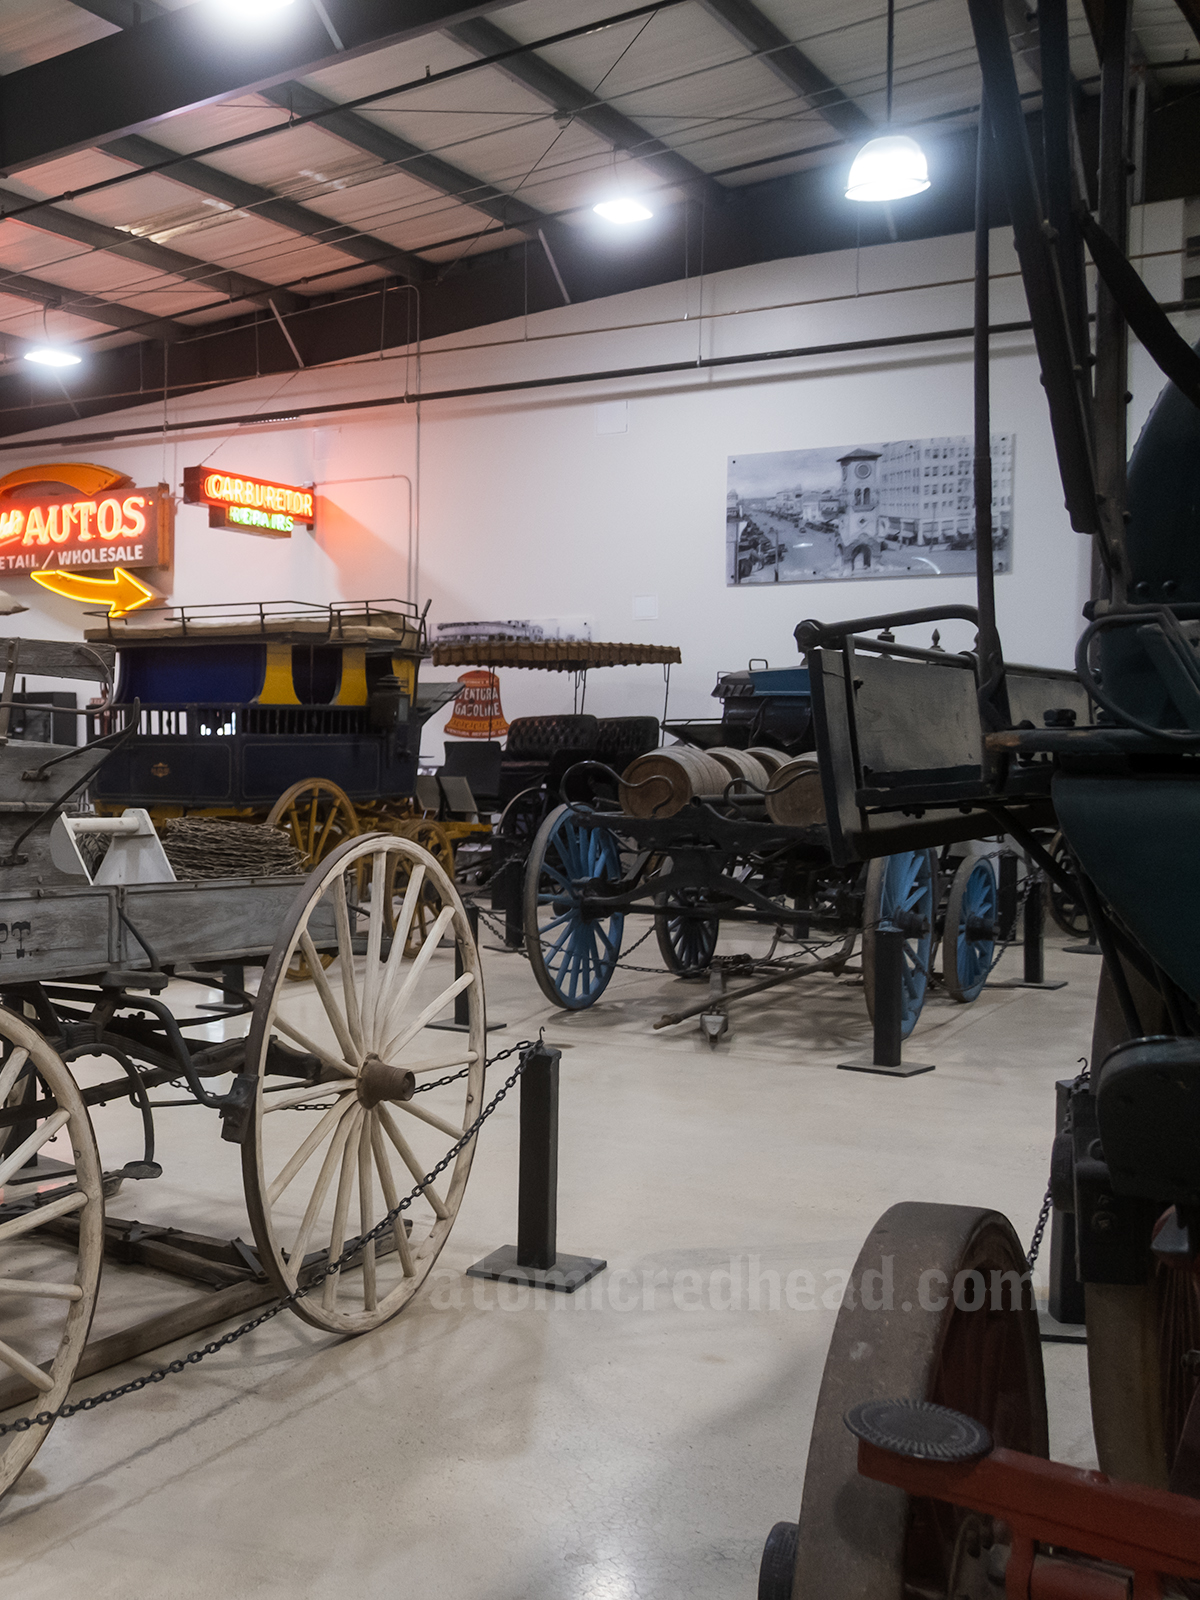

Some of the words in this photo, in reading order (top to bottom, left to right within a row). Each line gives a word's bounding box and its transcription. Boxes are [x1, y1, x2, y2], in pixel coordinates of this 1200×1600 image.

[204, 474, 313, 517] CARBURETOR
[21, 496, 146, 547] AUTOS
[228, 505, 294, 532] REPAIRS
[57, 545, 143, 565] WHOLESALE
[454, 702, 500, 717] GASOLINE
